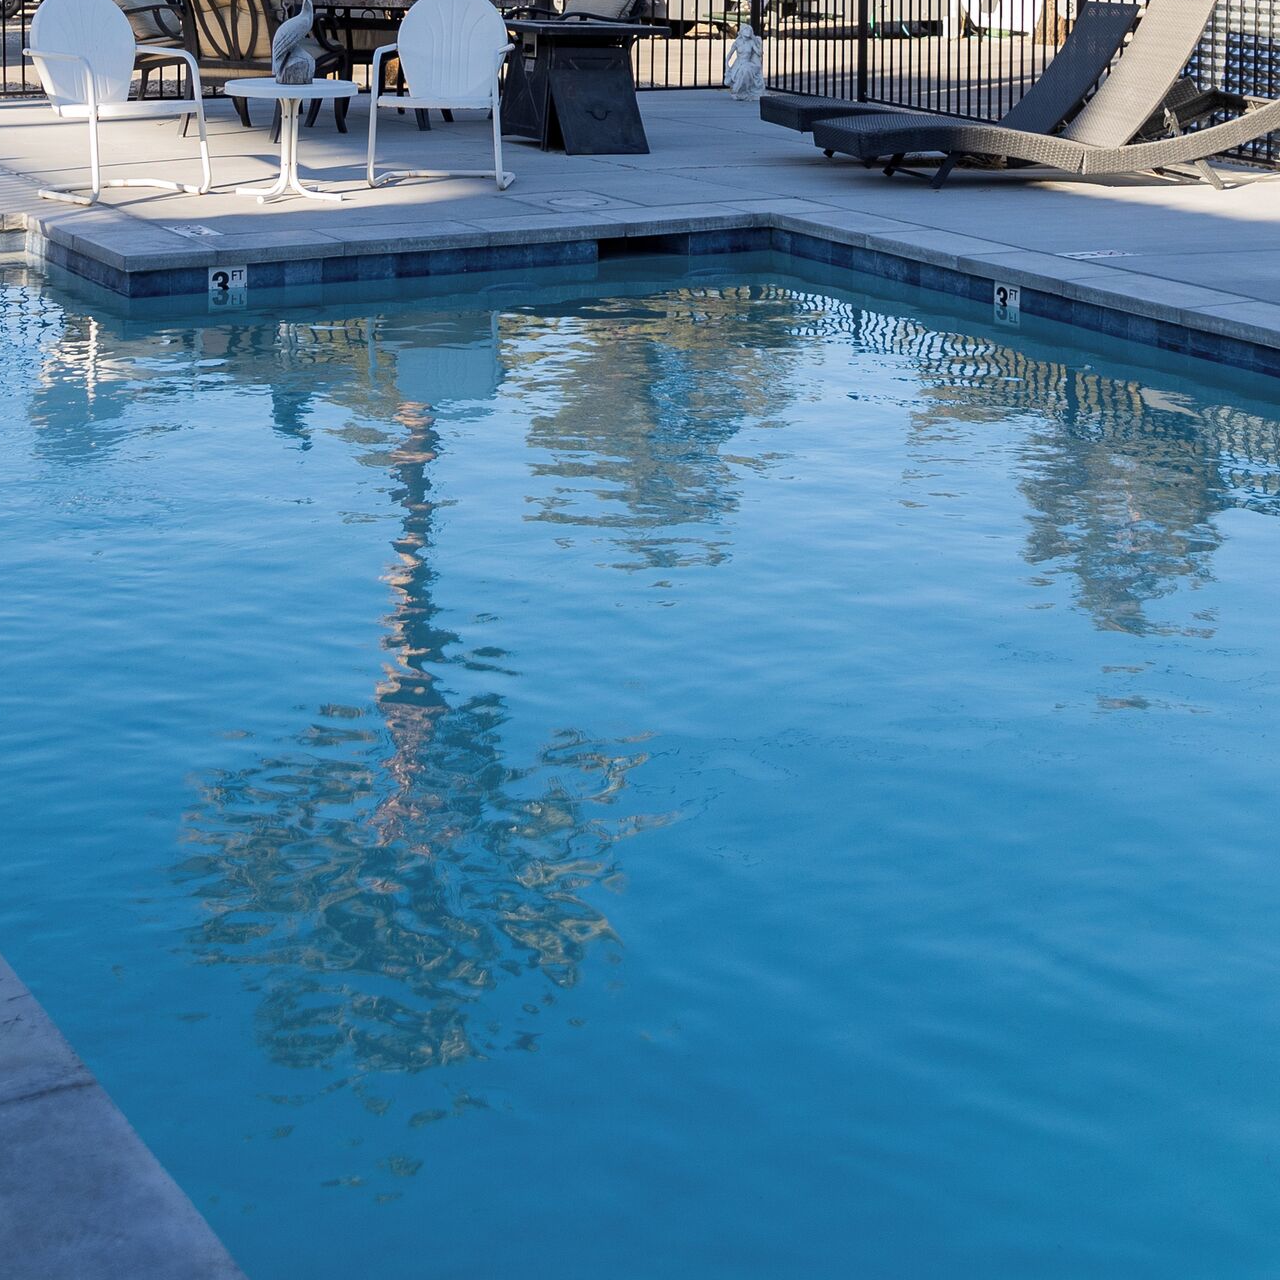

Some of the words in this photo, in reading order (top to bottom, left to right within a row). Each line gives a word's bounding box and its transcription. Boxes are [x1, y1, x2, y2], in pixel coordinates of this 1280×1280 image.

[212, 271, 230, 290] 3
[231, 269, 244, 281] FT
[996, 286, 1008, 307] 3
[1009, 288, 1018, 301] FT
